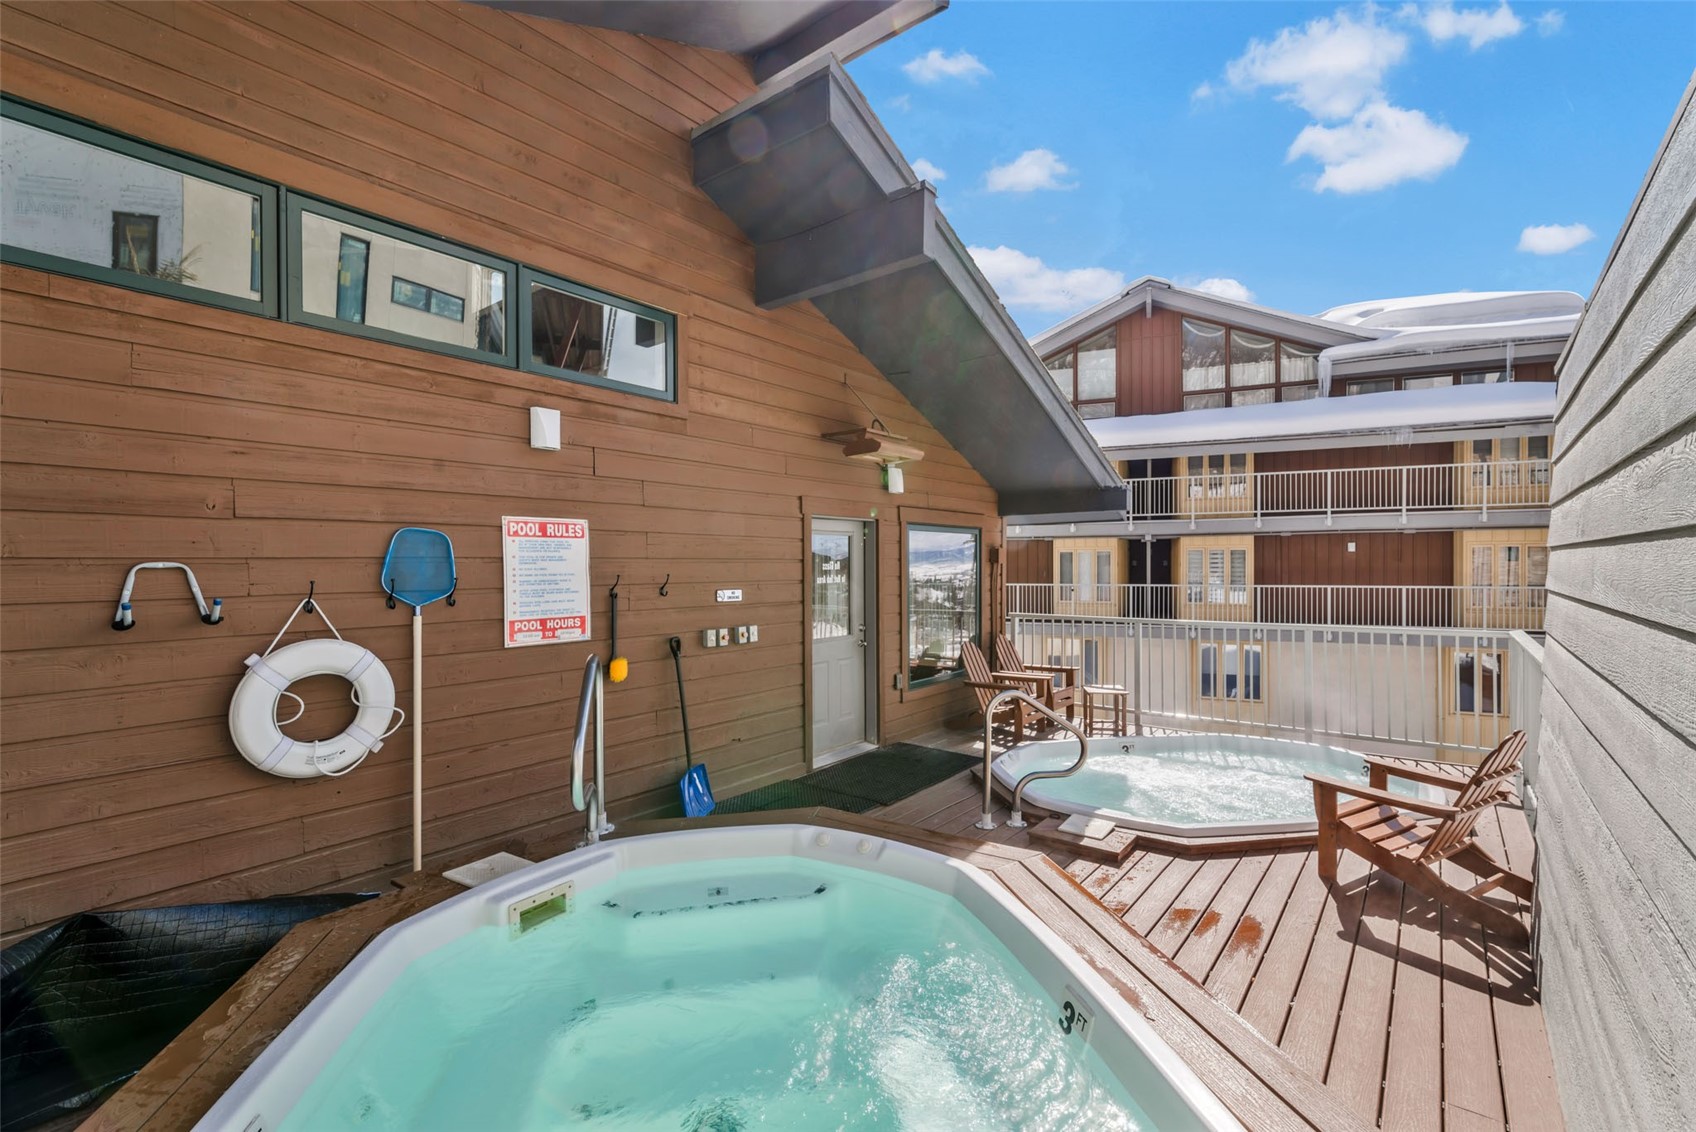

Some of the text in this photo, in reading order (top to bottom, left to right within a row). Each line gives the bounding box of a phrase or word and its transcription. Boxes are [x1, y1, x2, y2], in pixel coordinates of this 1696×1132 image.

[510, 522, 582, 537] POOL RULES
[514, 618, 581, 631] POOL HOURS
[1361, 766, 1369, 777] 3
[1058, 1001, 1087, 1035] 3 FT
